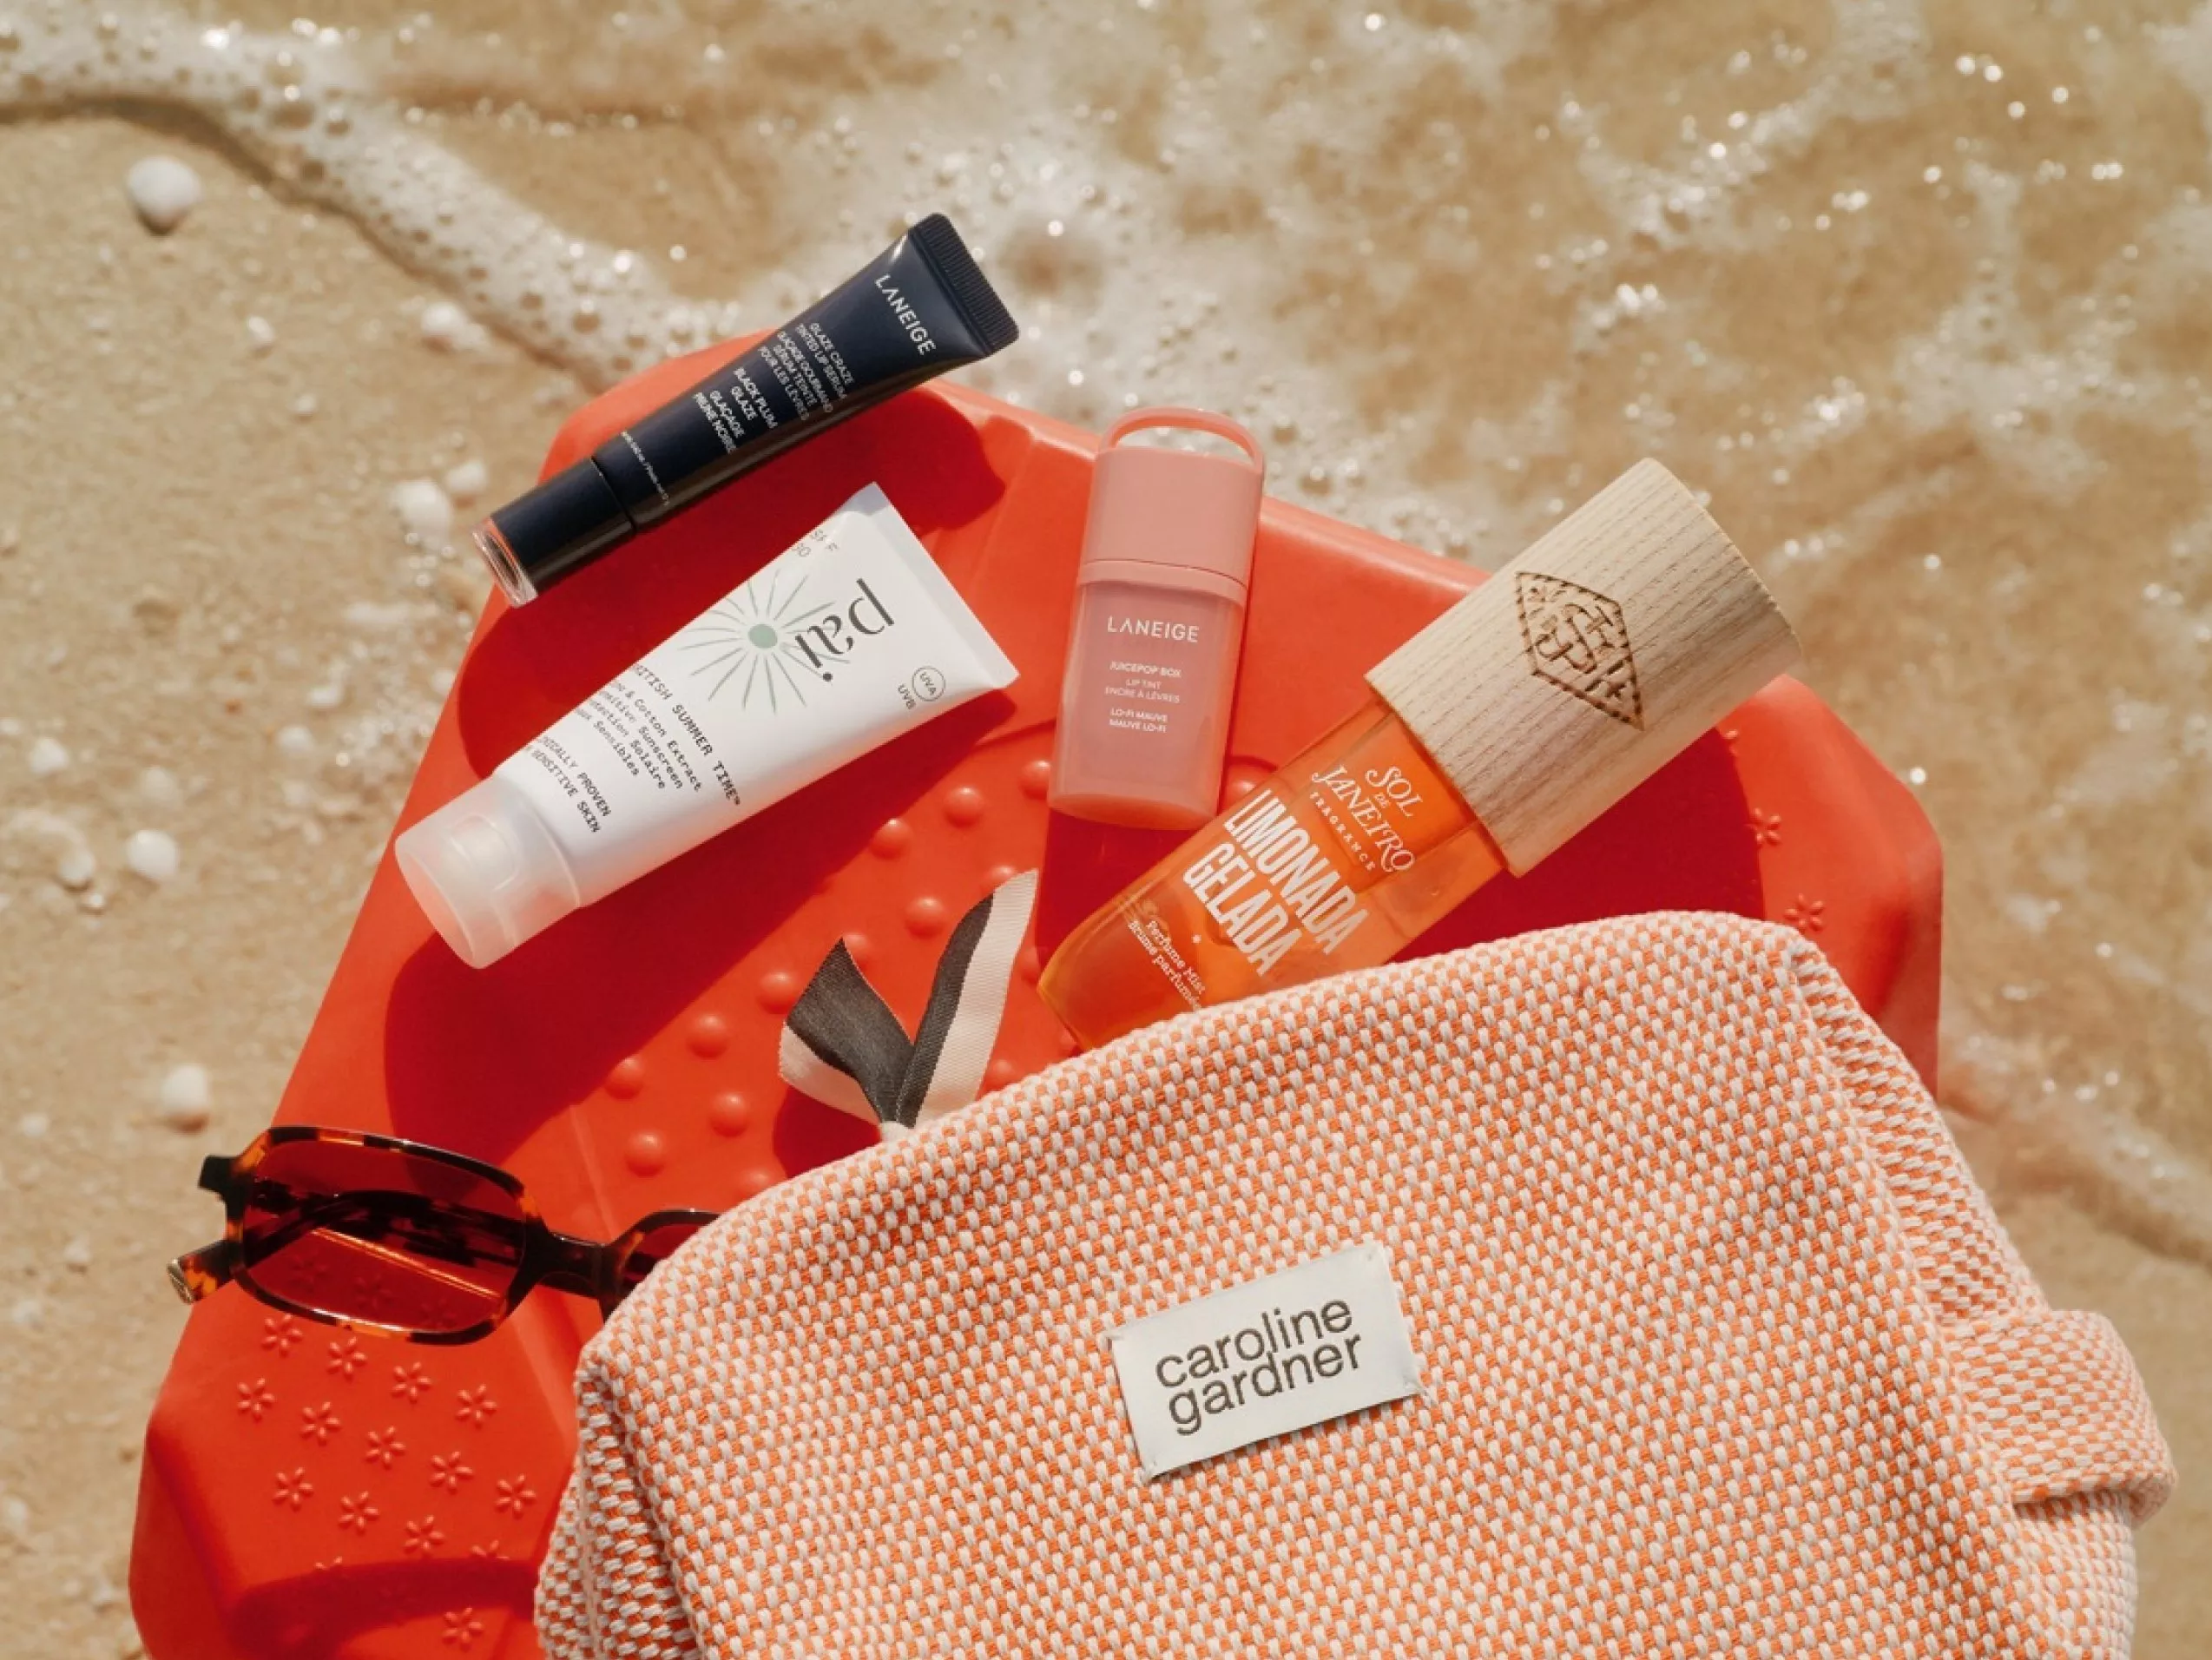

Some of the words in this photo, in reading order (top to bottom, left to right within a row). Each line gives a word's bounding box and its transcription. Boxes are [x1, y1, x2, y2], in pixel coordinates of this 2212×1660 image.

[874, 273, 937, 355] LANEIGE
[731, 386, 758, 420] GLAZE
[754, 397, 778, 429] PLUM
[794, 577, 894, 682] pai
[1107, 616, 1200, 643] LANEIGE
[898, 683, 917, 710] UVB
[919, 671, 938, 696] UVA
[1161, 667, 1182, 677] BOX
[593, 721, 640, 777] Sensibles
[635, 698, 667, 738] Cotton
[667, 740, 701, 792] Extract
[638, 726, 683, 789] Sunscreen
[672, 704, 713, 755] SUMMER
[629, 740, 665, 789] Solaire
[1366, 767, 1423, 817] SOL
[576, 772, 612, 817] PROVEN
[576, 800, 602, 833] SKIN
[1312, 765, 1415, 873] JANEIRO
[1309, 792, 1376, 871] FRAGRANCE
[1222, 787, 1369, 955] LIMONADA
[1183, 841, 1302, 977] GELADA
[1147, 920, 1185, 969] Perfume
[1183, 966, 1205, 995] Mist
[1155, 1300, 1353, 1388] caroline
[1169, 1334, 1362, 1436] gardner
